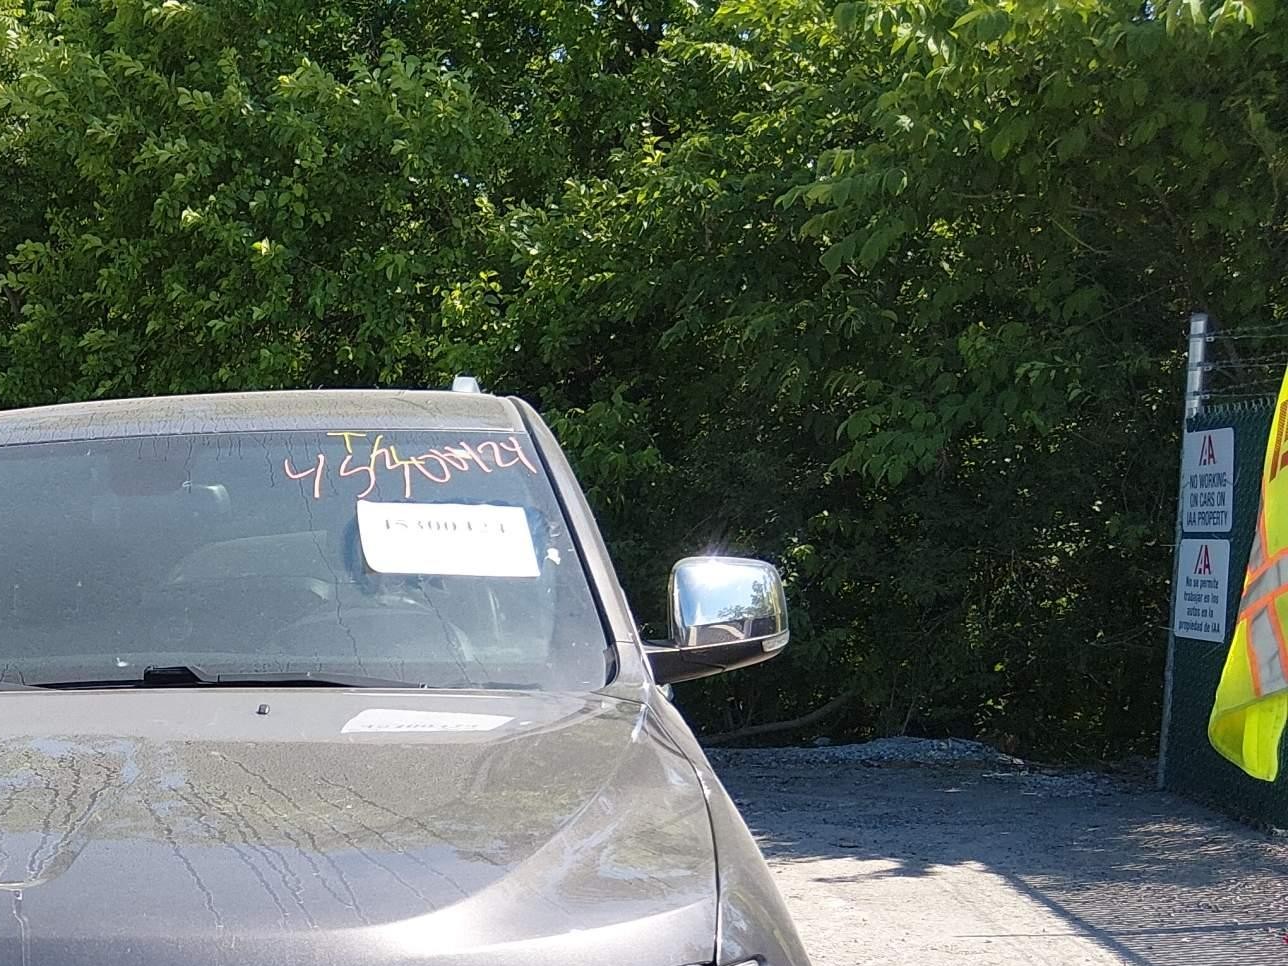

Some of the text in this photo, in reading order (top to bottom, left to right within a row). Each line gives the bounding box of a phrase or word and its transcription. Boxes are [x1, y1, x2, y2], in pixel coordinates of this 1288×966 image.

[1190, 472, 1227, 488] NO WORKING
[1190, 492, 1226, 507] ON CARS ON
[1187, 511, 1228, 527] IAA PROPERTY
